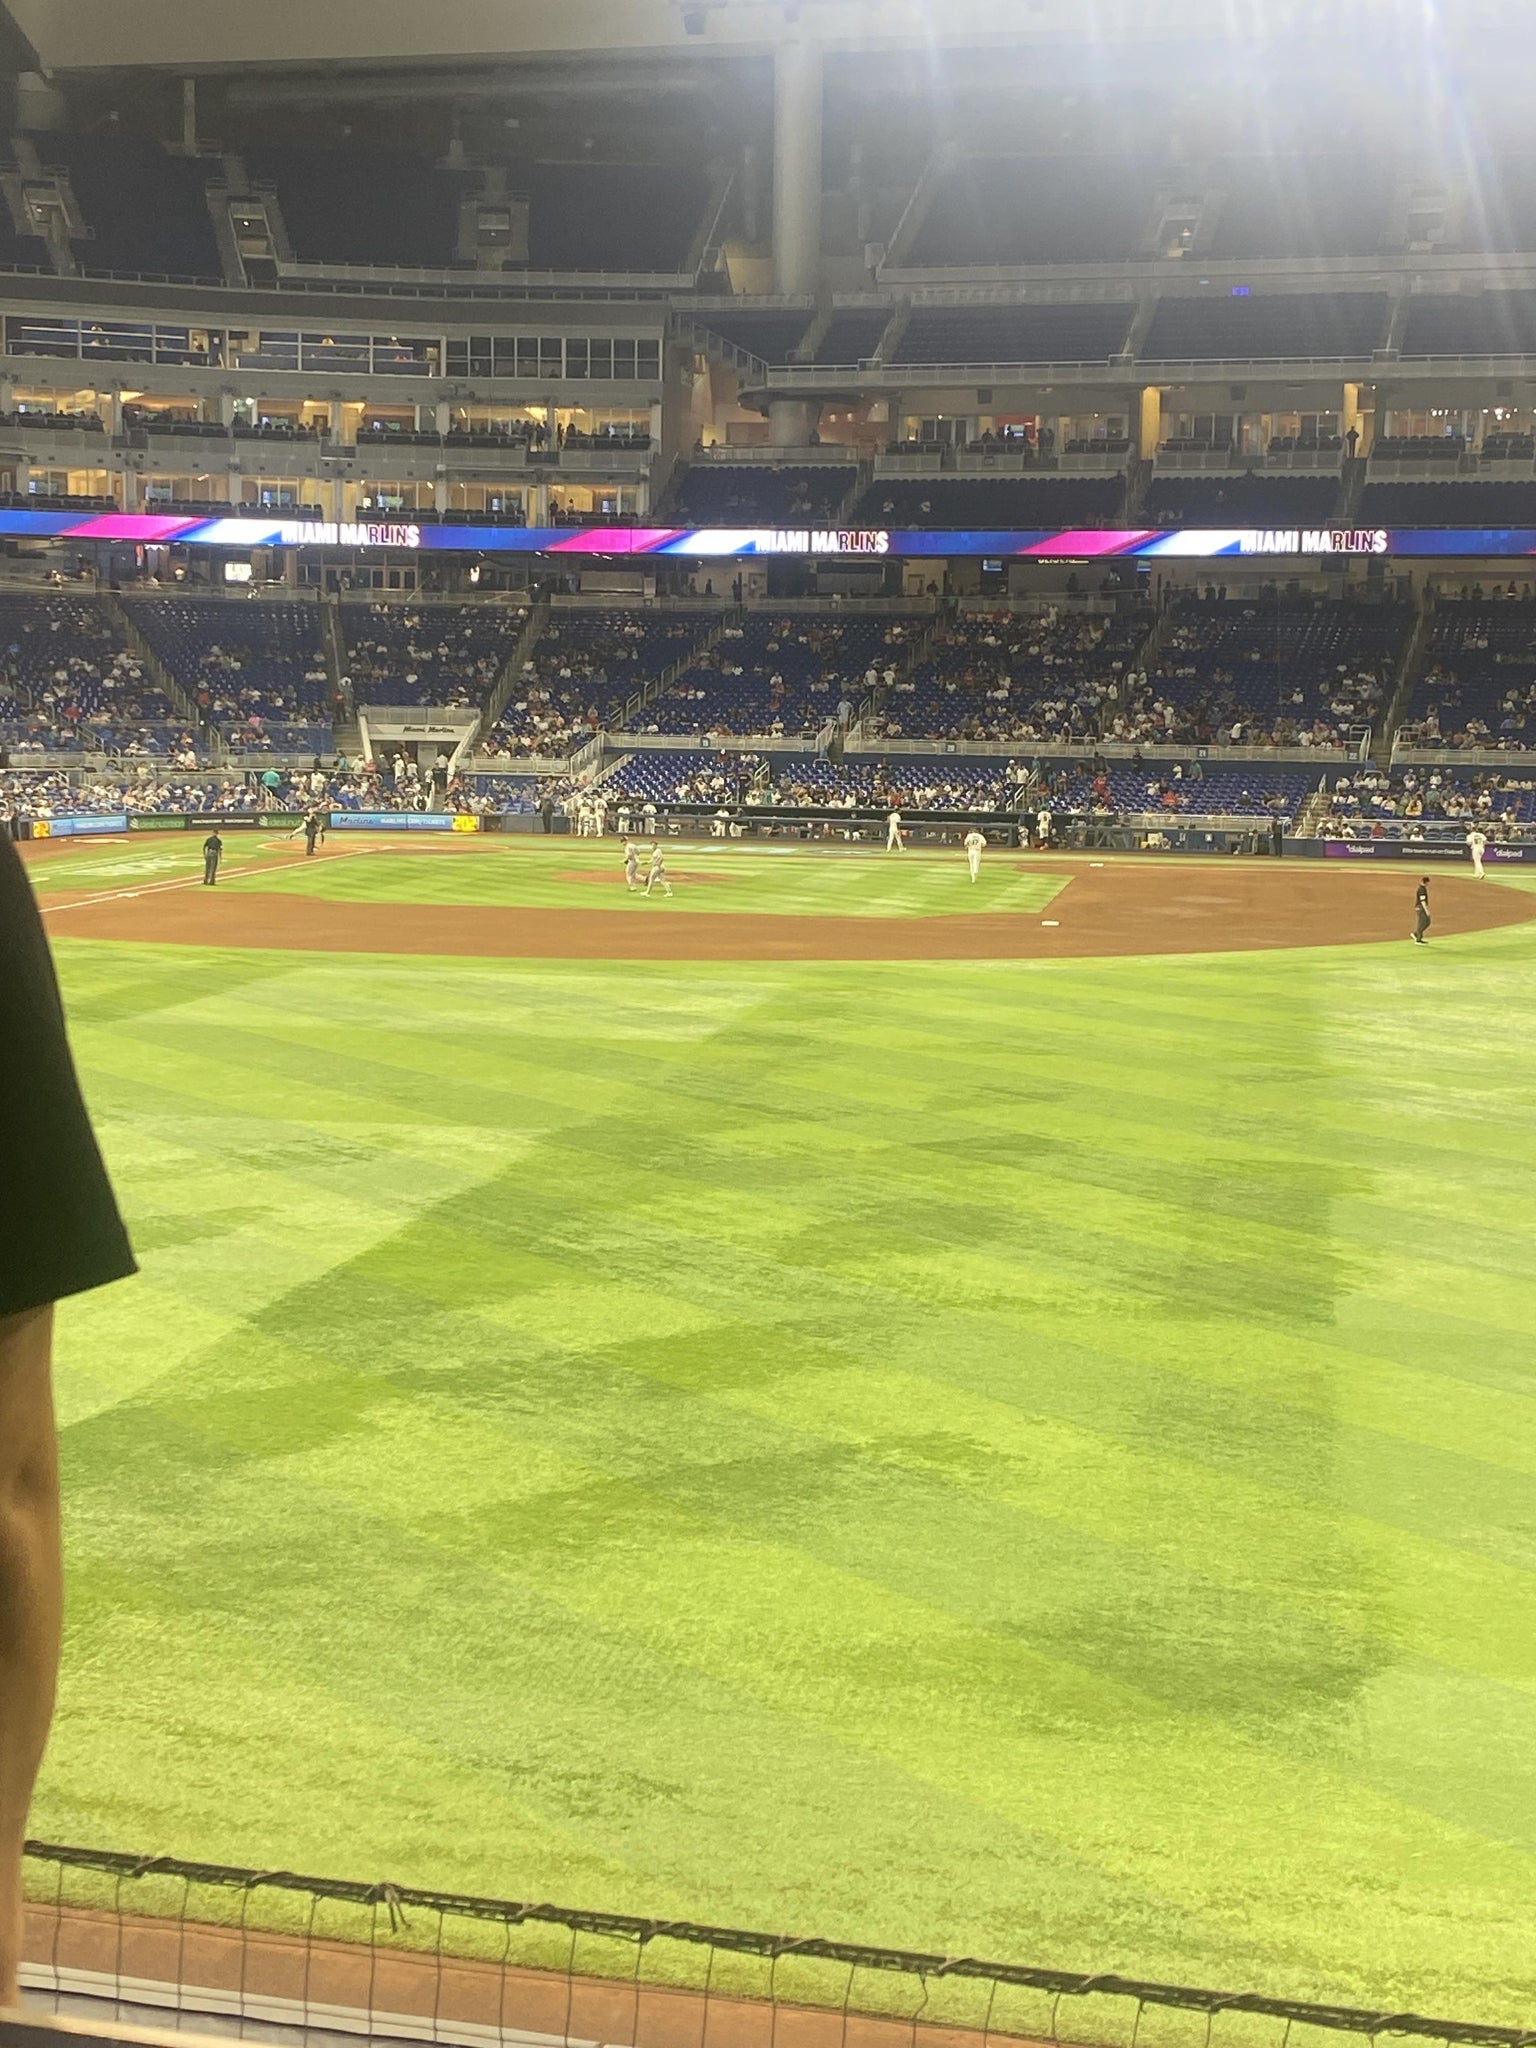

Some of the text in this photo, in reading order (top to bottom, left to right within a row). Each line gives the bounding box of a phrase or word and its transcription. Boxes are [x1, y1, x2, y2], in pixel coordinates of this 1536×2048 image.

[340, 523, 420, 547] MARLINS
[811, 530, 889, 553] MARLINS
[1302, 530, 1387, 553] MARLINS
